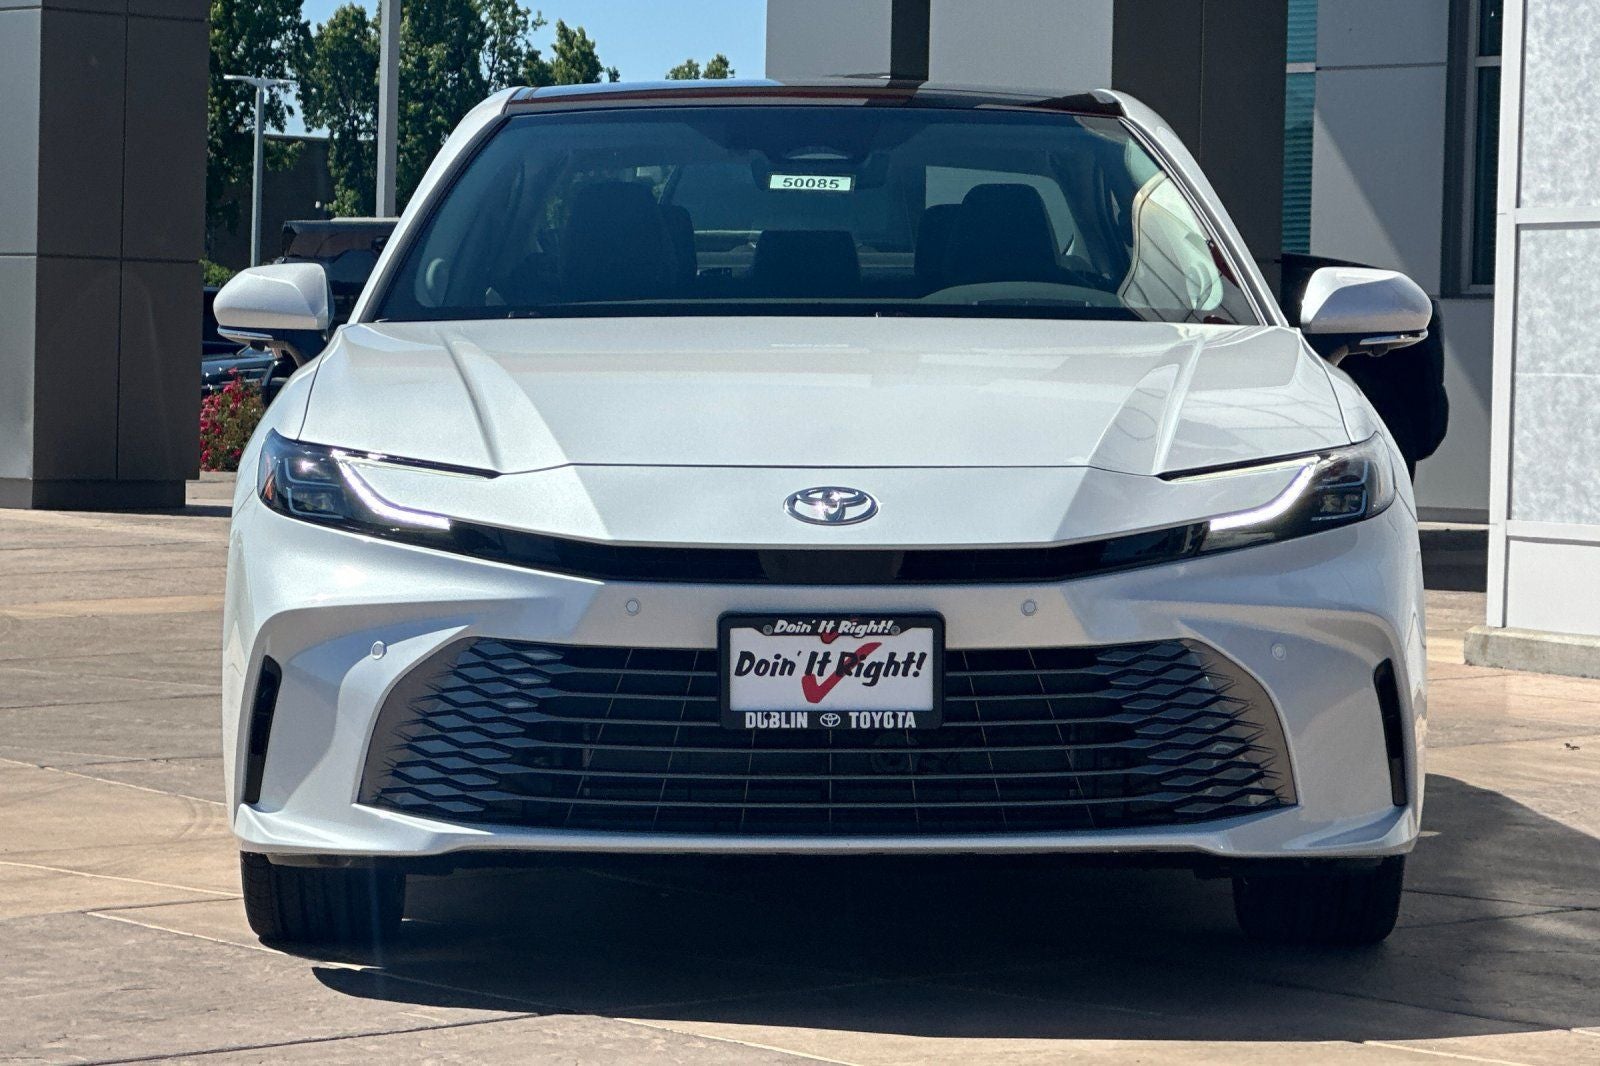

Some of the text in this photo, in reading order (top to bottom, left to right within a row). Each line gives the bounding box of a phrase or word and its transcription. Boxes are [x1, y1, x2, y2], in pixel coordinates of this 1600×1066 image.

[782, 177, 840, 189] 50085
[774, 619, 894, 638] Doin' It Right!
[734, 650, 928, 687] Doin' It Right!
[745, 711, 917, 729] DUBLIN TOYOTA
